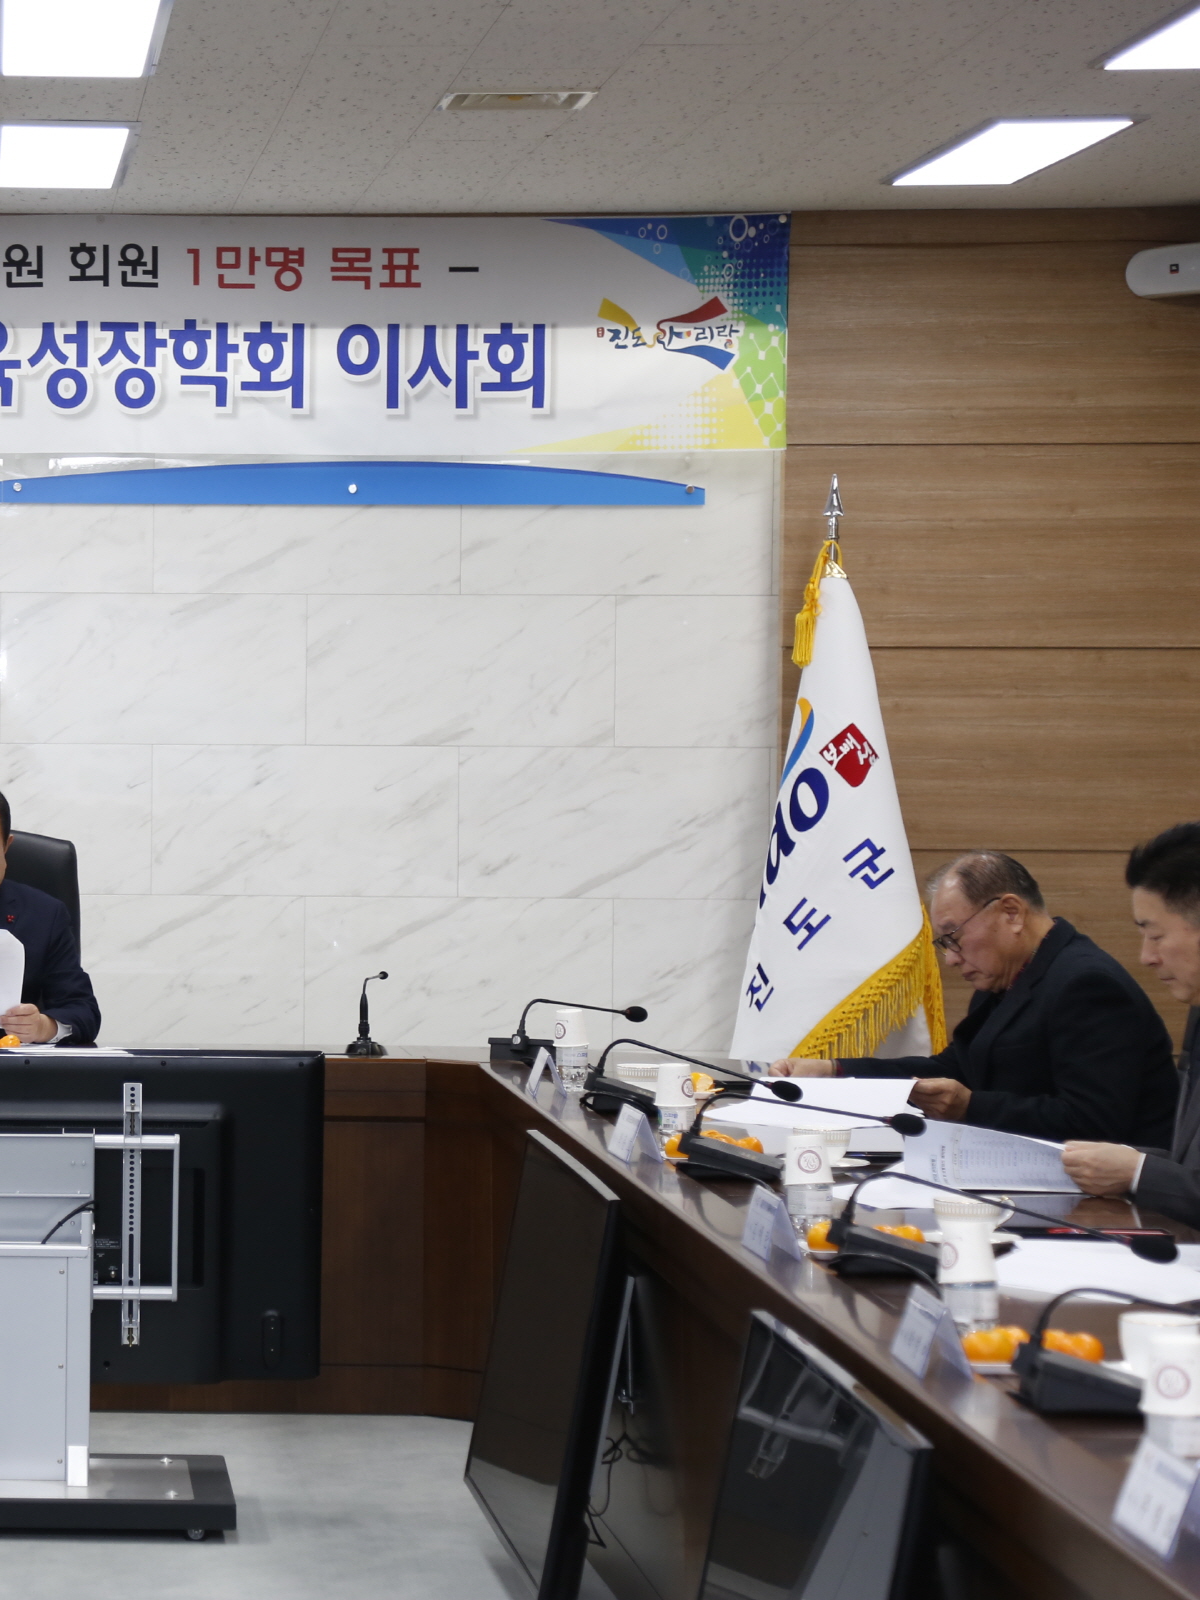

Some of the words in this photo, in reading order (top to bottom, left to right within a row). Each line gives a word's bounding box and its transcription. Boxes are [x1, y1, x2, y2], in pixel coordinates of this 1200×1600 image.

[68, 242, 160, 288] 회원
[187, 246, 304, 291] 1만명
[331, 246, 421, 289] 목표
[336, 322, 546, 410] 이사회
